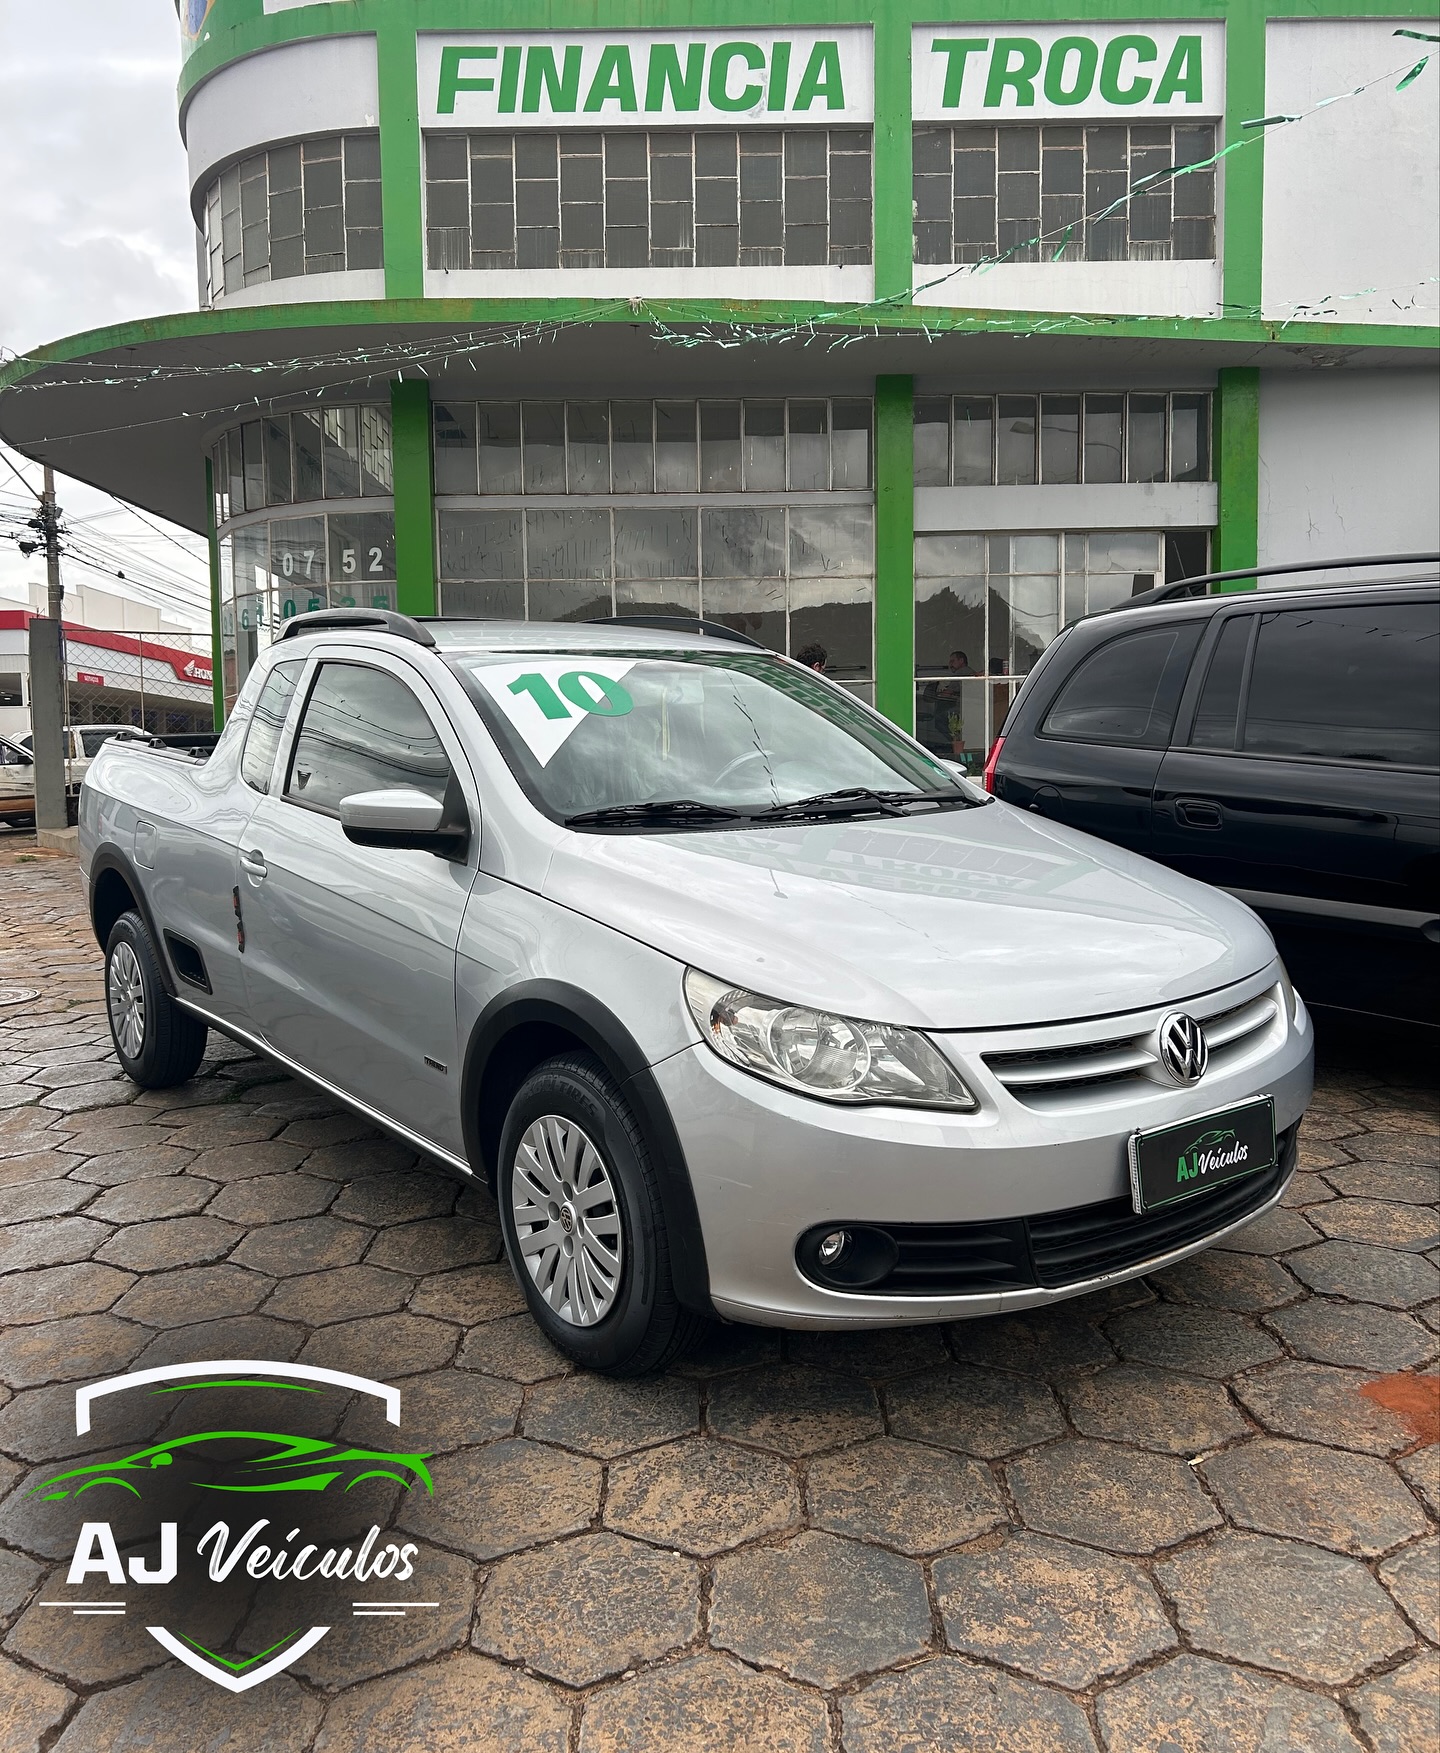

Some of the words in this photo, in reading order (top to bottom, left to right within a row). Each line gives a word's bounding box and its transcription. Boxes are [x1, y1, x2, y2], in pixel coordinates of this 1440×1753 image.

[436, 40, 846, 115] FINANCIA
[930, 34, 1204, 109] TROCA
[506, 671, 635, 720] 10
[1176, 1152, 1199, 1183] AJ
